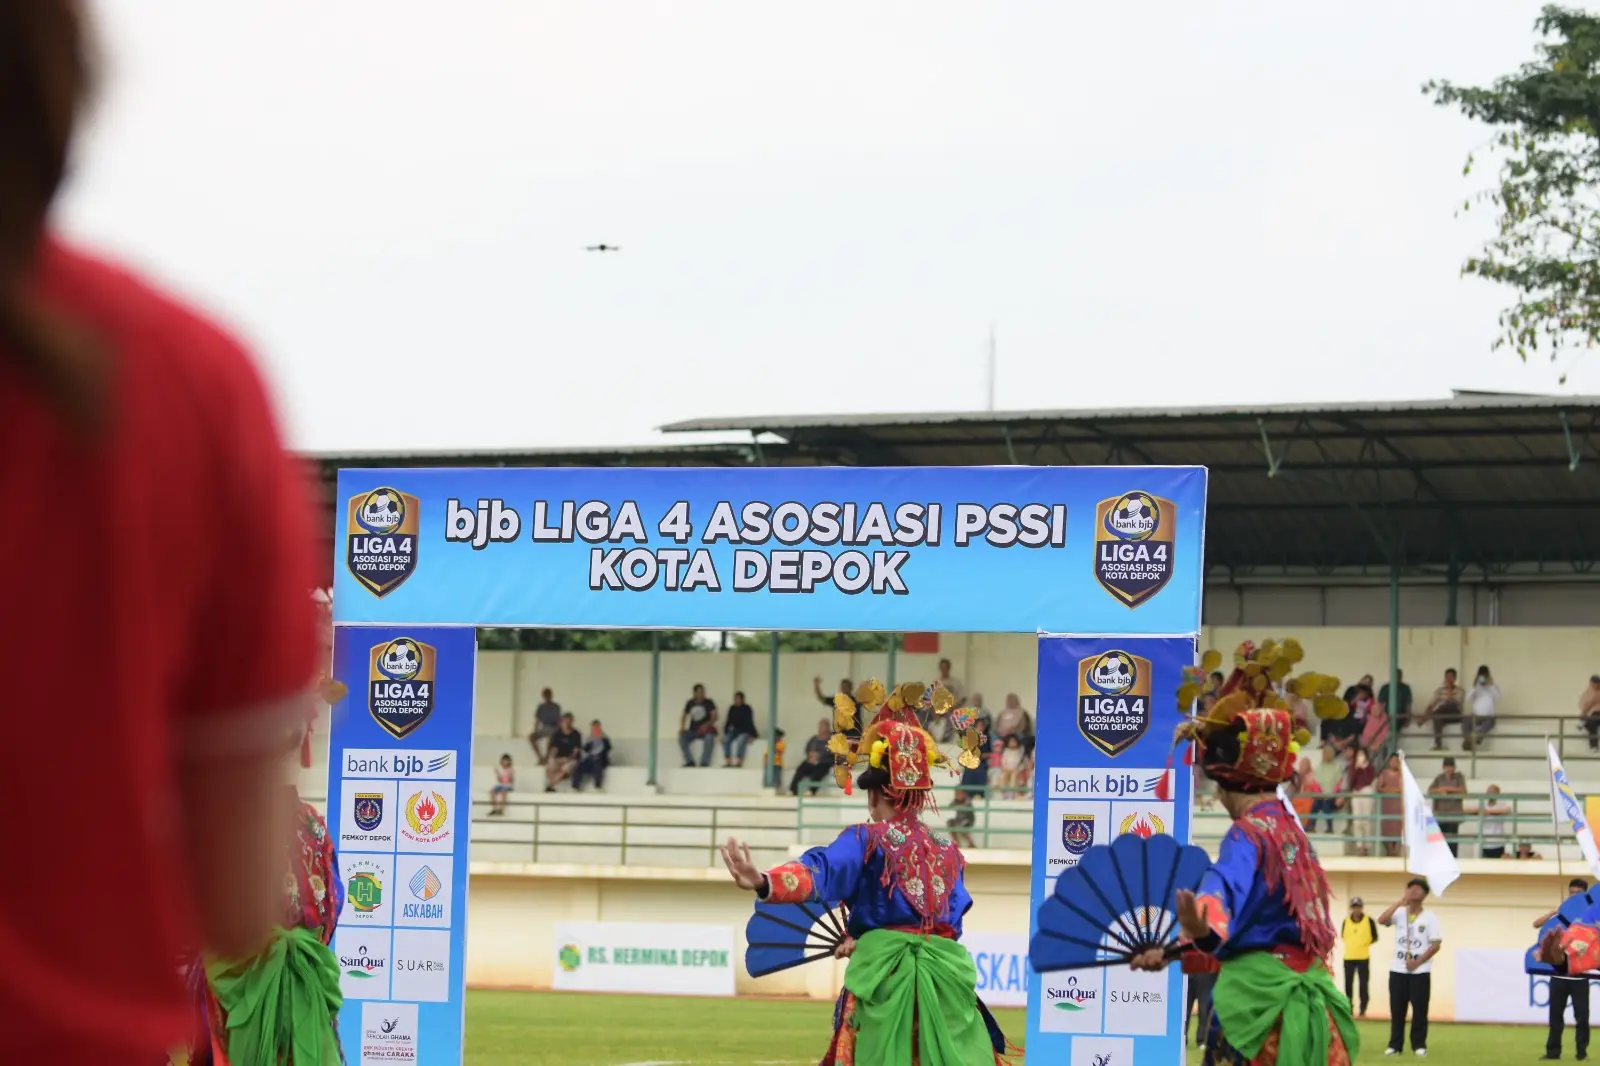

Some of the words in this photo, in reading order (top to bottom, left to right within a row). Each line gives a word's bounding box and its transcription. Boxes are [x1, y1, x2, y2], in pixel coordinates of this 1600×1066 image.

[387, 515, 399, 524] bjb
[445, 498, 521, 550] bjb
[532, 500, 648, 544] LIGA
[658, 500, 693, 544] 4
[701, 500, 942, 547] ASOSIASI
[954, 502, 1067, 548] PSSI
[1116, 520, 1136, 528] bank
[1139, 520, 1153, 530] bjb
[353, 537, 397, 554] LIGA
[399, 537, 411, 554] 4
[352, 555, 391, 563] ASOSIASI
[1101, 544, 1150, 561] LIGA
[1153, 544, 1167, 561] 4
[357, 563, 377, 571] KOTA
[589, 547, 721, 592] KOTA
[733, 548, 910, 595] DEPOK
[1101, 563, 1144, 571] ASOSIASI
[1146, 564, 1166, 572] PSSI
[1130, 572, 1160, 580] DEPOK
[386, 662, 403, 670] bank
[405, 662, 417, 671] bjb
[1097, 676, 1116, 684] bank
[1118, 677, 1131, 685] bjb
[374, 683, 415, 698] LIGA
[417, 683, 429, 698] 4
[1084, 698, 1129, 714] LIGA
[1131, 698, 1144, 714] 4
[1084, 715, 1123, 723] ASOSIASI
[1088, 723, 1109, 731] KOTA
[1111, 723, 1138, 731] DEPOK
[347, 755, 389, 772] bank
[393, 755, 423, 776] bjb
[1054, 774, 1100, 792] bank
[1105, 774, 1139, 797] bjb
[431, 831, 450, 842] DEPOK
[346, 860, 385, 874] HERMINA
[403, 904, 443, 918] ASKABAH
[340, 956, 384, 968] SanQua
[613, 947, 678, 965] HERMINA
[681, 949, 729, 967] DEPOK
[967, 952, 1029, 991] SKA
[1046, 987, 1096, 1000] SanQua
